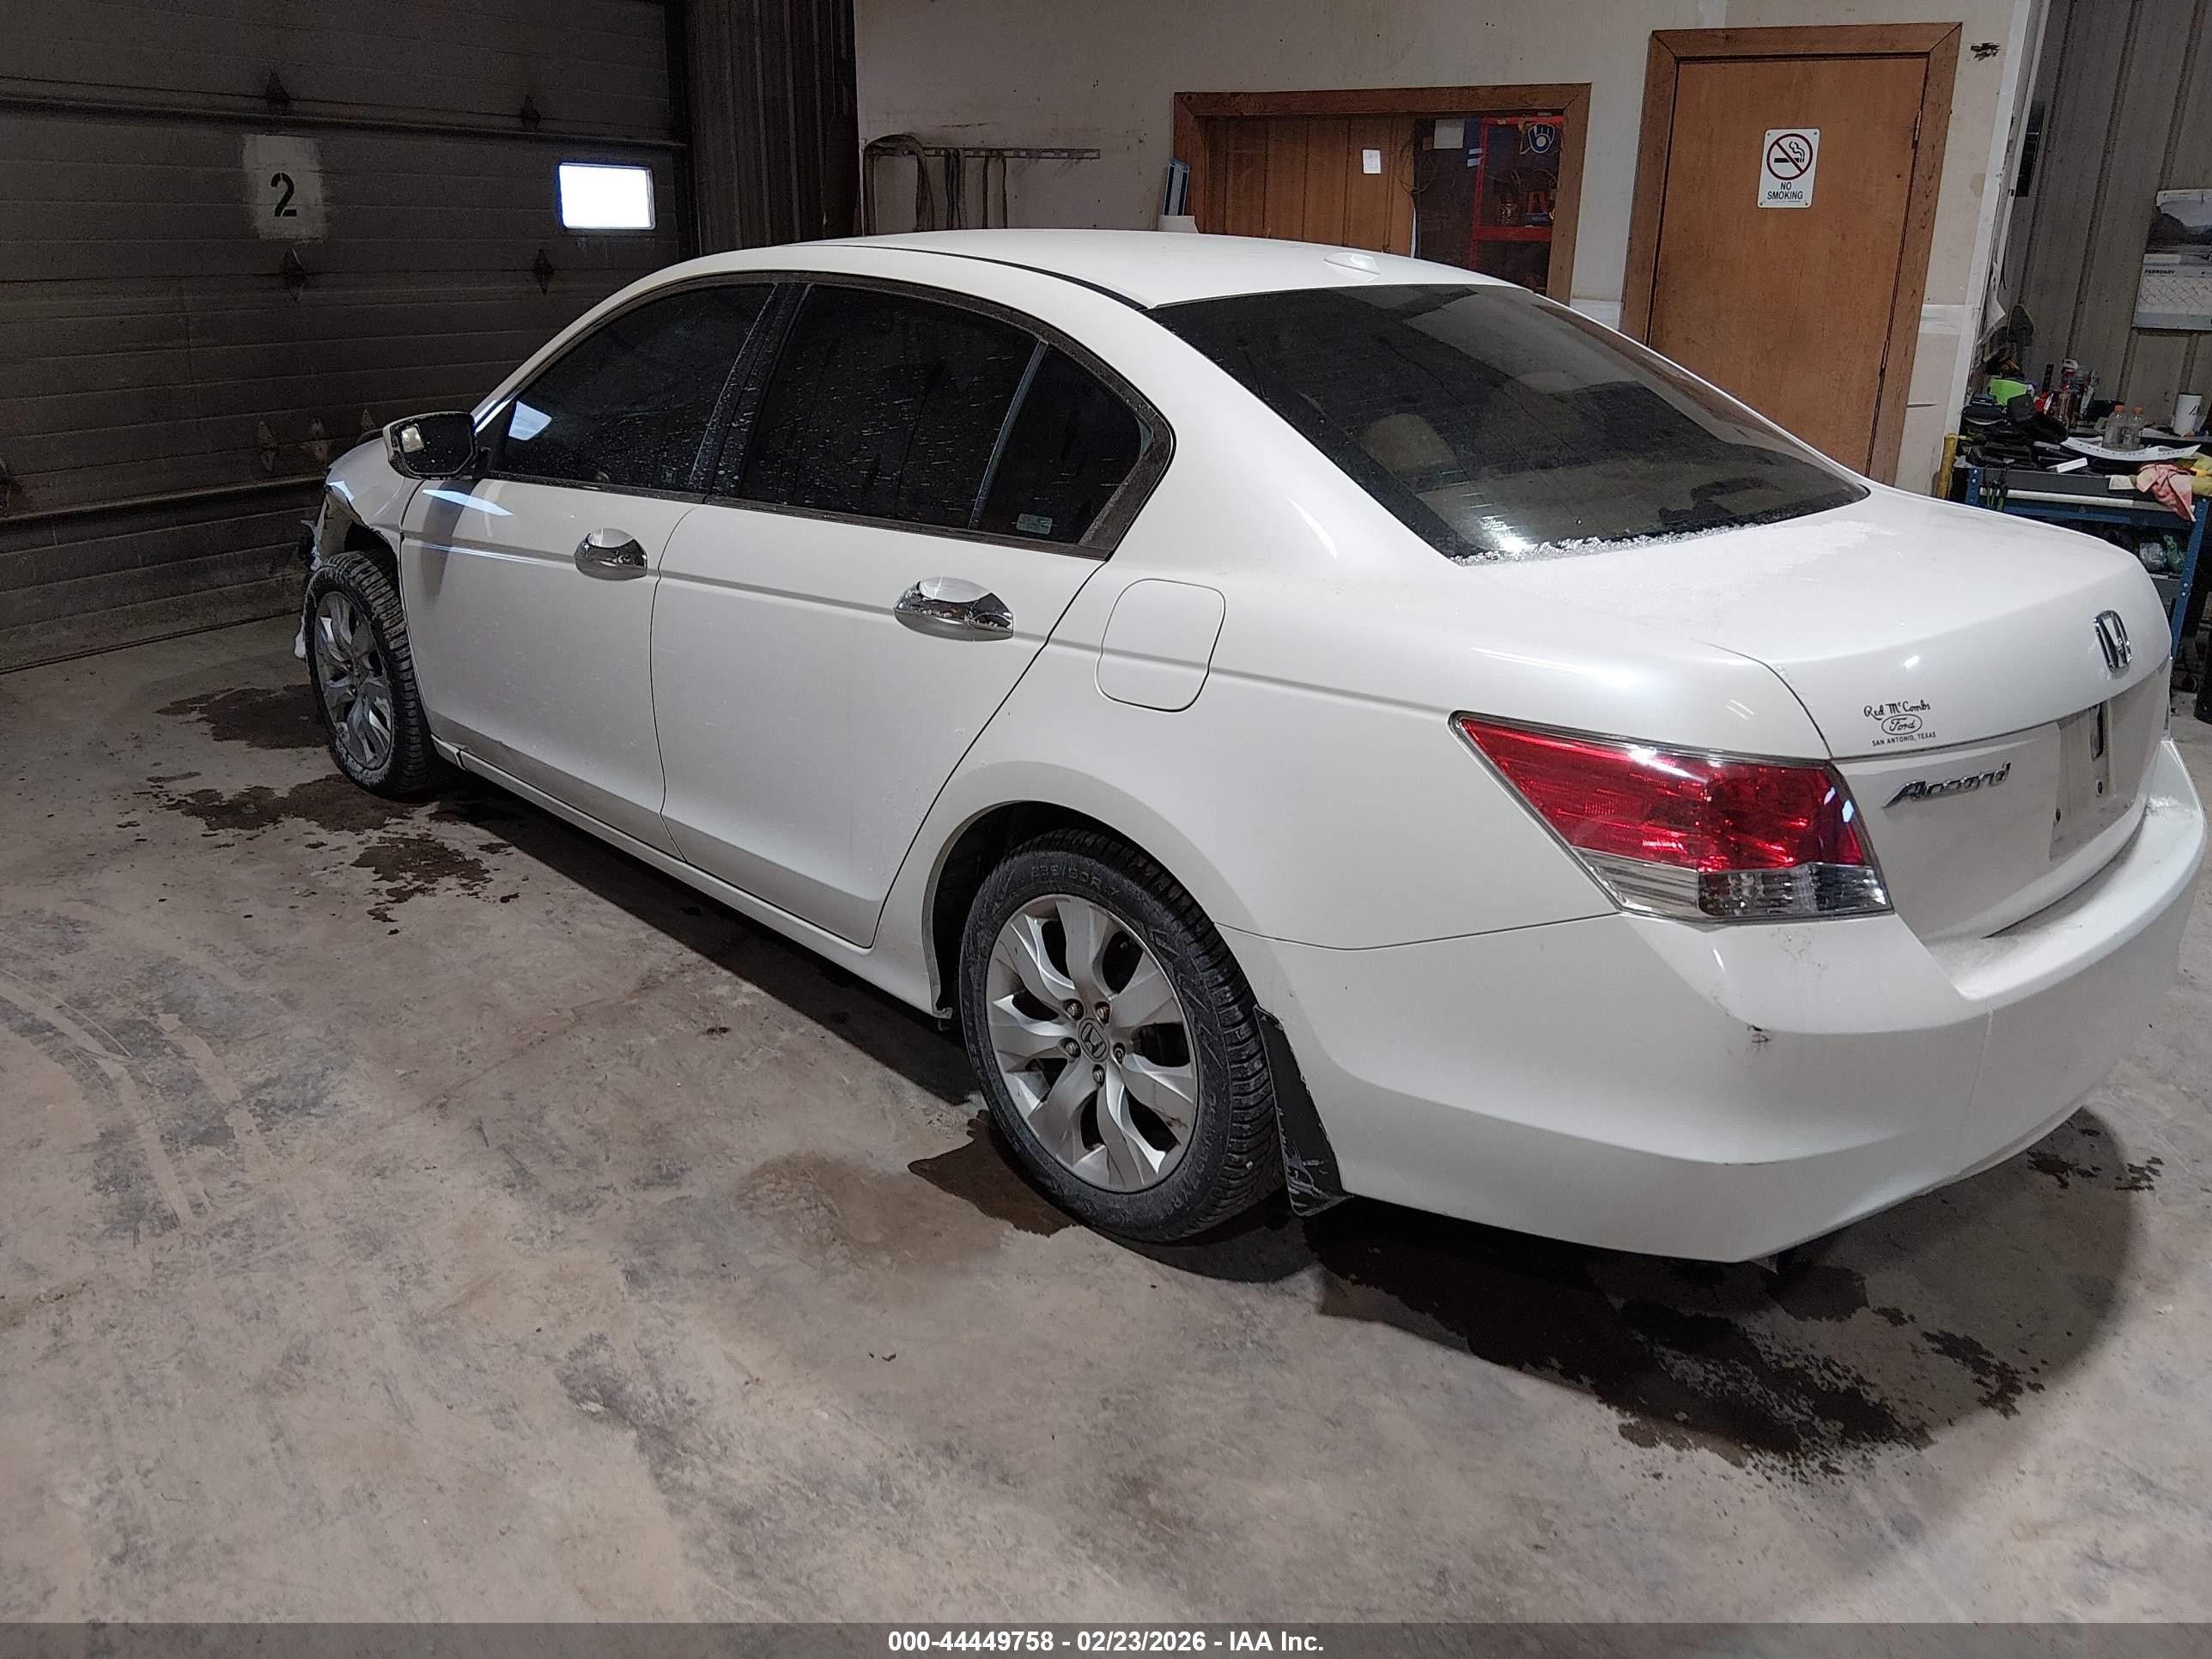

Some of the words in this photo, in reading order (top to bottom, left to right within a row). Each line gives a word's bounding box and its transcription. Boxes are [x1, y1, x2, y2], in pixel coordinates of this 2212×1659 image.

[1780, 181, 1792, 191] NO
[270, 172, 297, 217] 2
[1766, 191, 1803, 200] SMOKING
[1889, 717, 1916, 732] Ford
[1872, 738, 1885, 747] SAN
[1887, 734, 1917, 744] ANTONIO,
[1917, 731, 1936, 740] TEXAS
[1882, 762, 2011, 809] Accord
